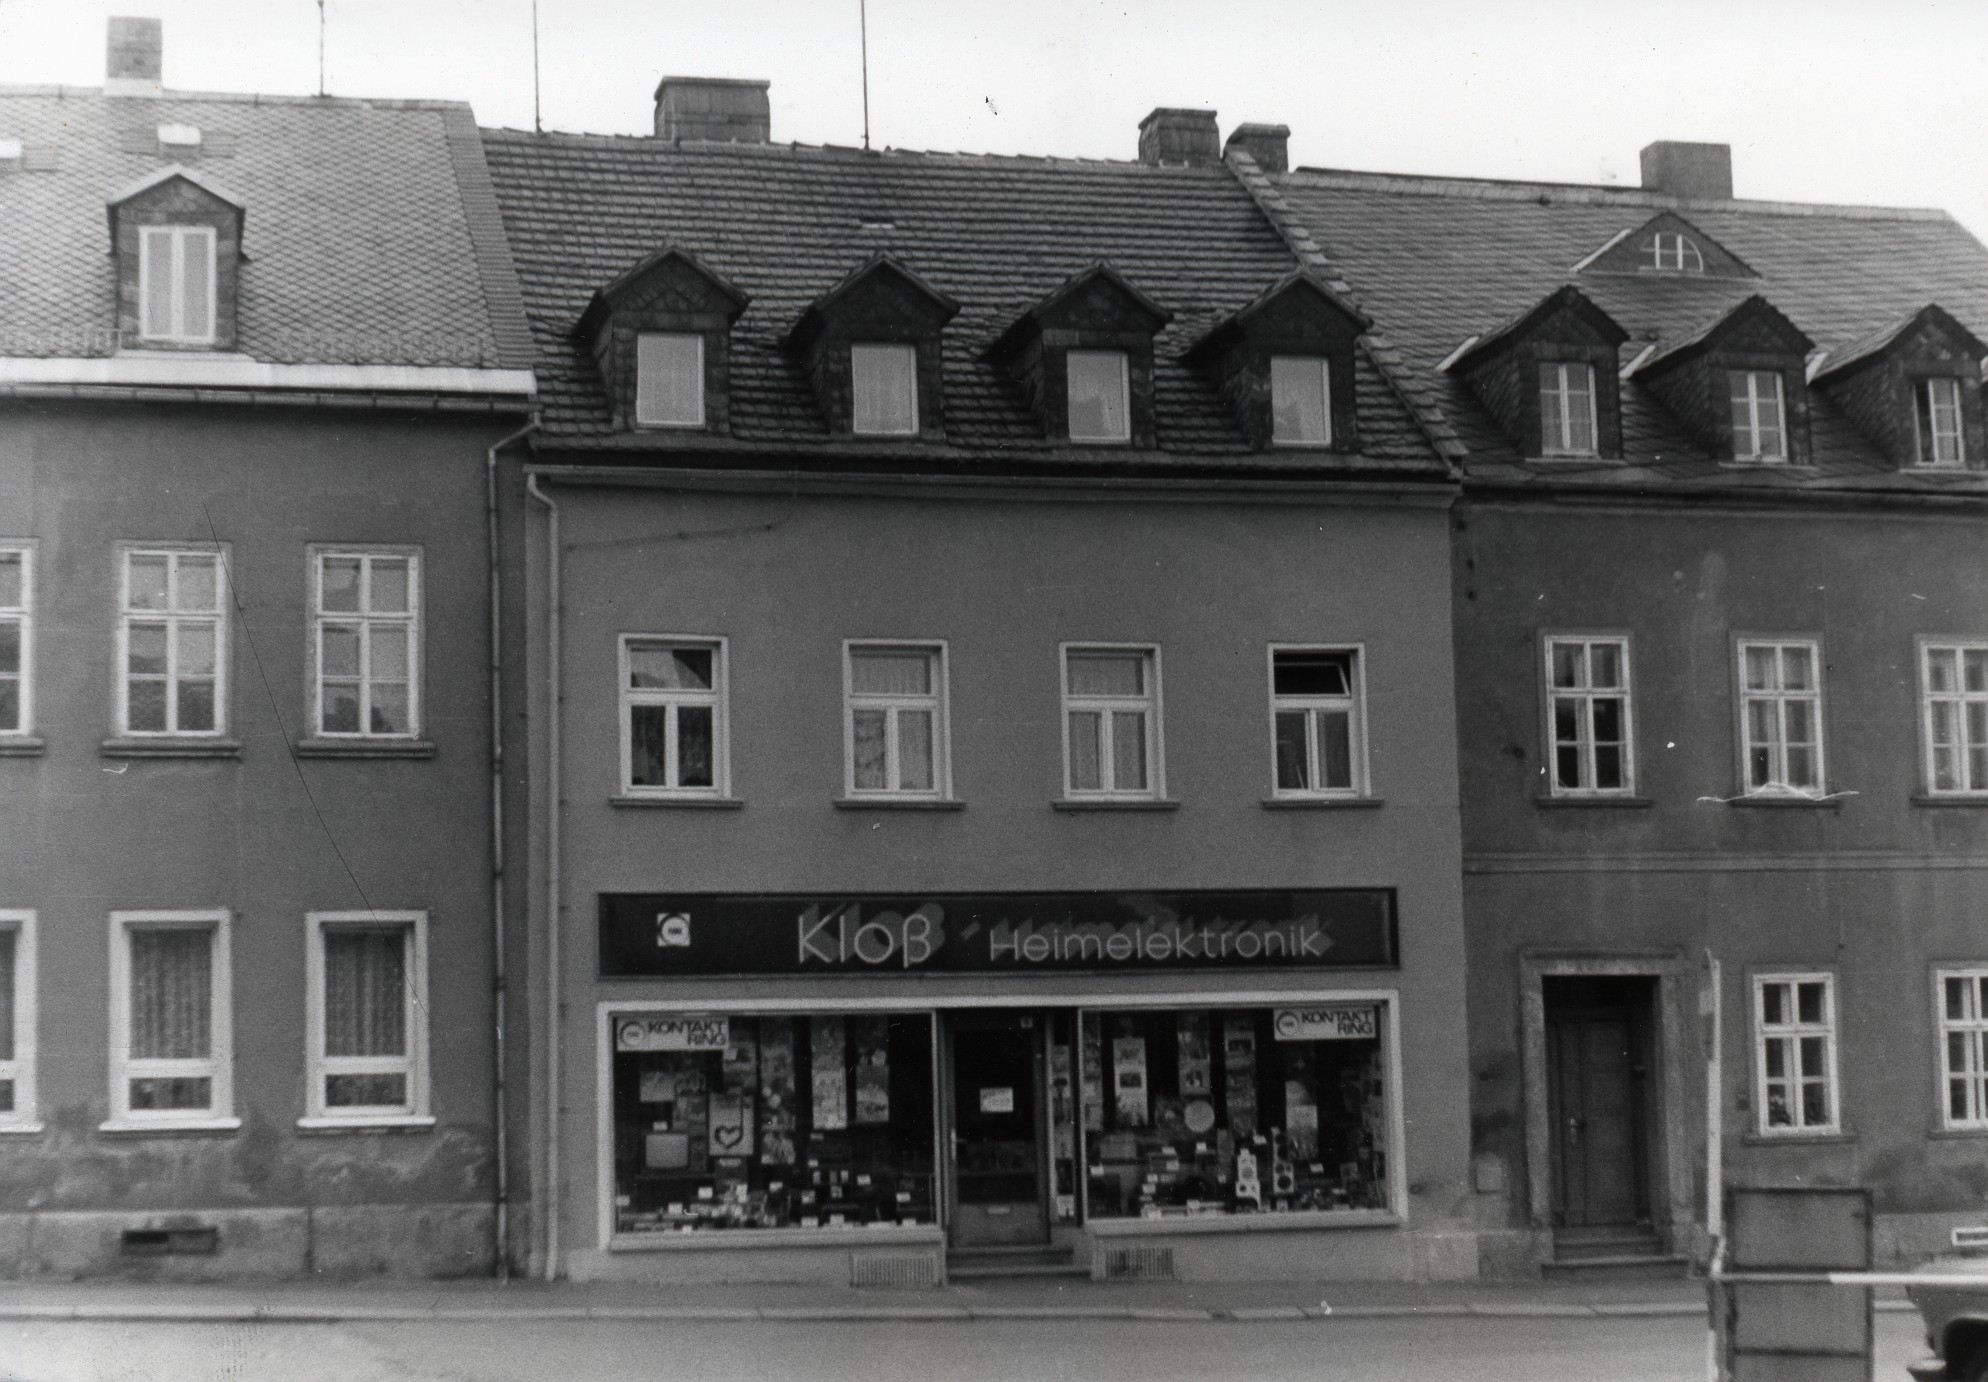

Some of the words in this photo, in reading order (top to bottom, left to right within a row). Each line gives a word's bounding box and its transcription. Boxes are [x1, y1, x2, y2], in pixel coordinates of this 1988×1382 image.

[799, 904, 934, 968] Kloß
[989, 922, 1326, 962] Heimelektronik
[1301, 1010, 1372, 1023] KONTAKT
[648, 1020, 724, 1033] KONTAKT
[1337, 1022, 1373, 1034] RING
[686, 1032, 726, 1046] RING
